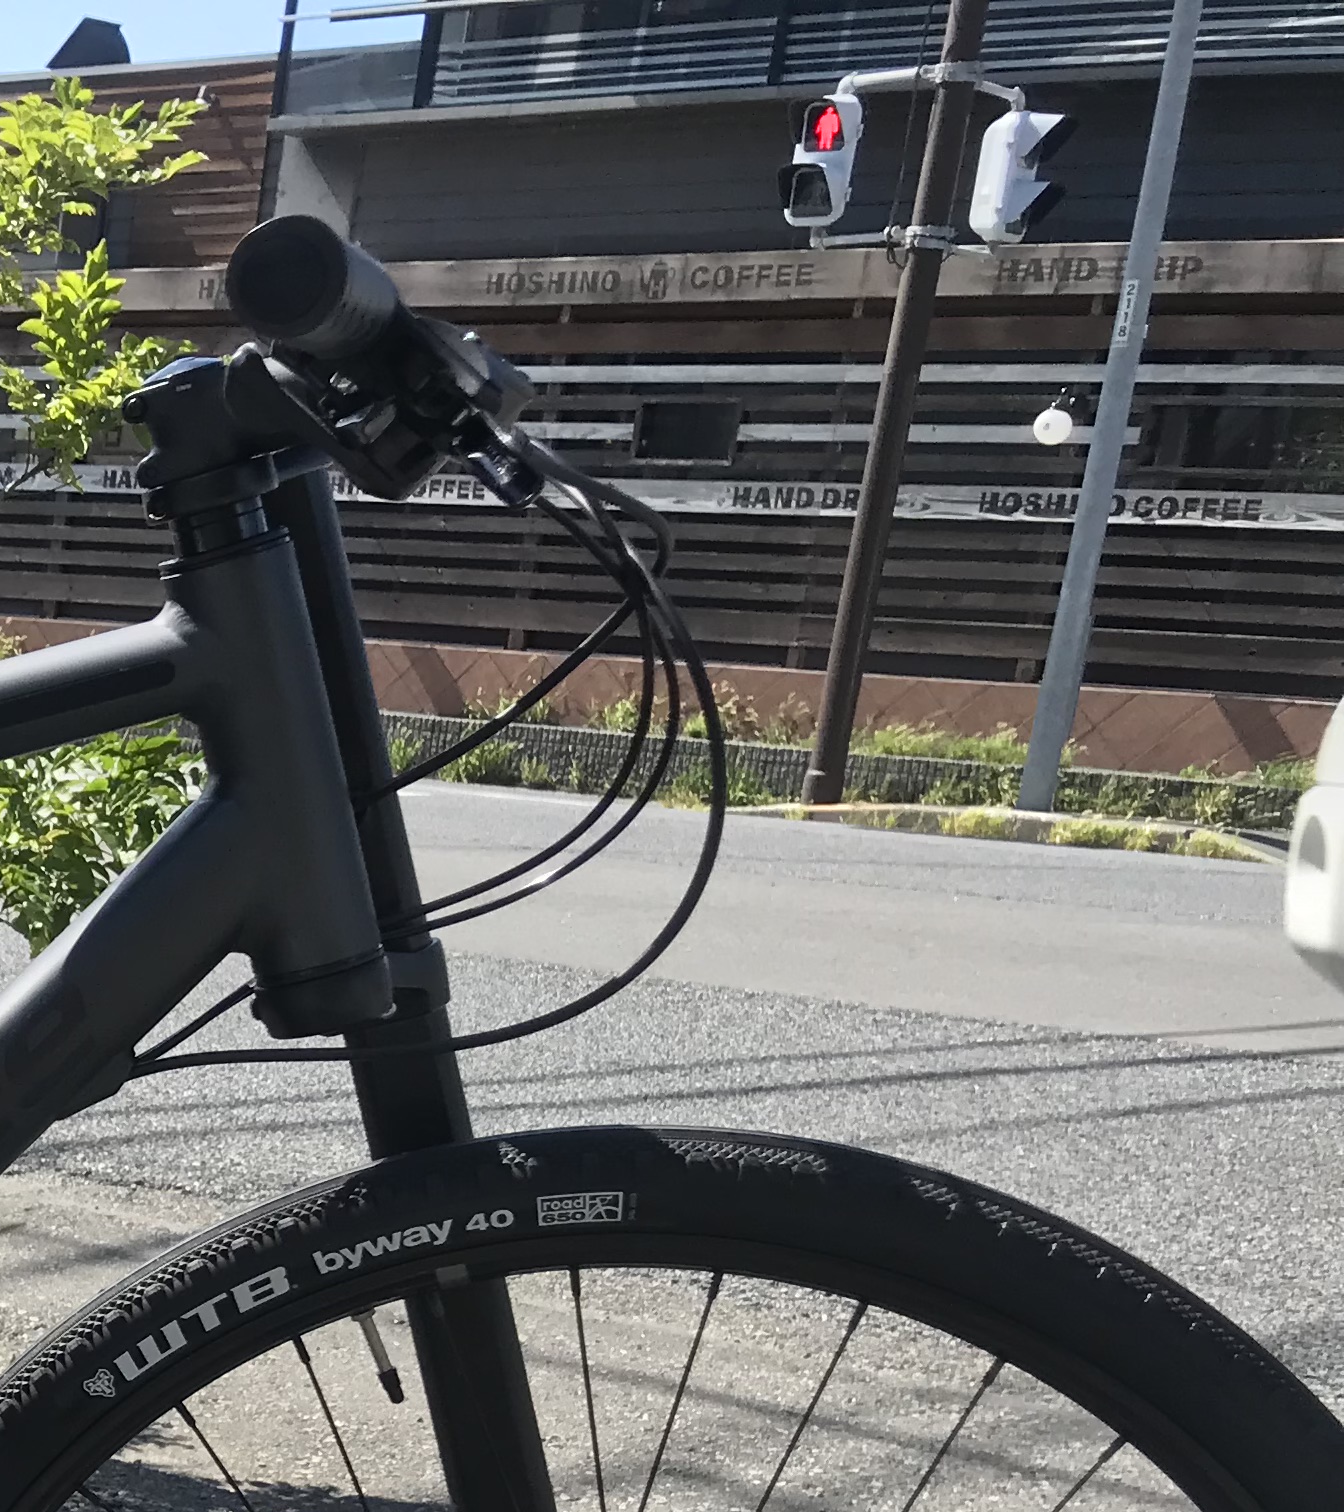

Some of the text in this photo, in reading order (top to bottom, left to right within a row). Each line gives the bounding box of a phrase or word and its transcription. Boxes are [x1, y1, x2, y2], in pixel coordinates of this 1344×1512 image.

[486, 262, 814, 295] HOSHINO COFFEE
[998, 256, 1099, 282] HAND
[1118, 283, 1136, 338] 2118
[732, 486, 862, 512] HAND DR
[978, 491, 1263, 522] HOSHIO COFFEE
[541, 1211, 587, 1224] 650
[542, 1196, 584, 1211] road
[114, 1208, 514, 1382] WTB byway 40
